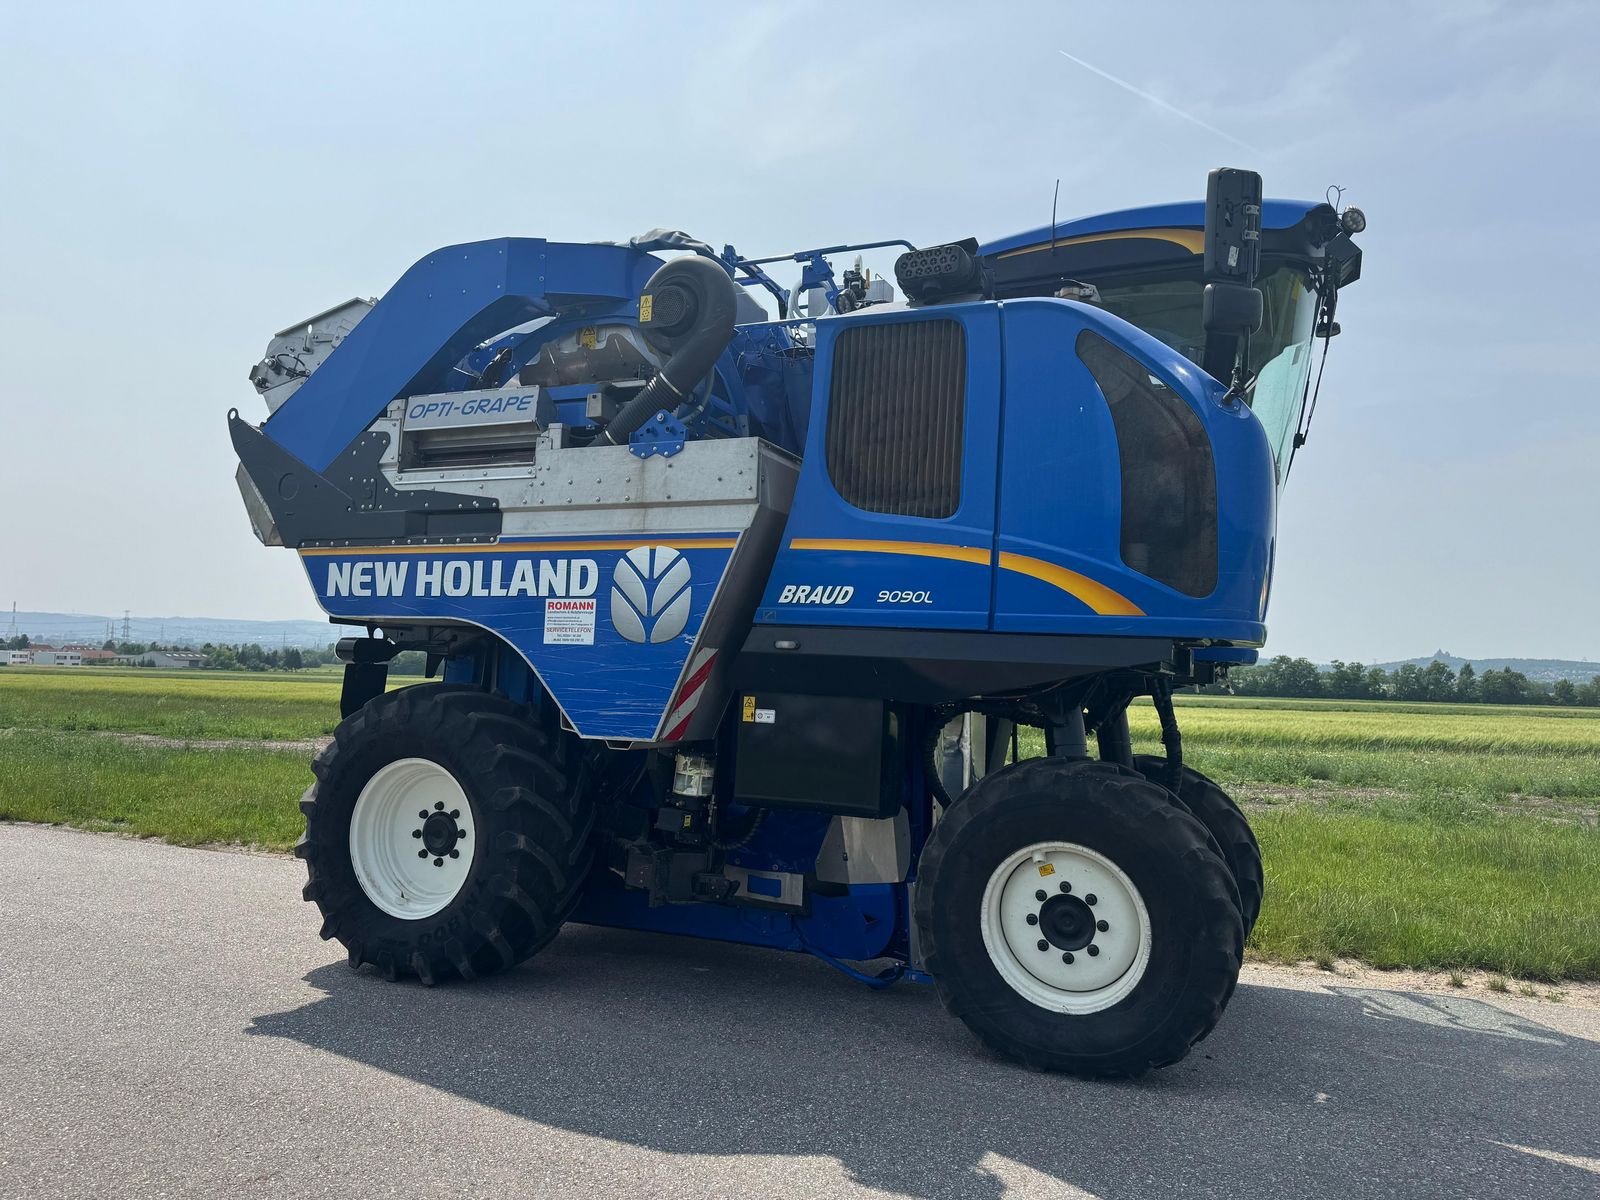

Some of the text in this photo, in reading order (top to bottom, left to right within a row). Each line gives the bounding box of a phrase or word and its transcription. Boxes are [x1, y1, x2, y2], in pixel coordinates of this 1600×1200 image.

[409, 394, 535, 419] OPTI-GRAPE
[326, 557, 599, 598] NEW HOLLAND
[778, 585, 854, 605] BRAUD
[877, 590, 933, 604] 9090L
[547, 601, 594, 611] ROMANN
